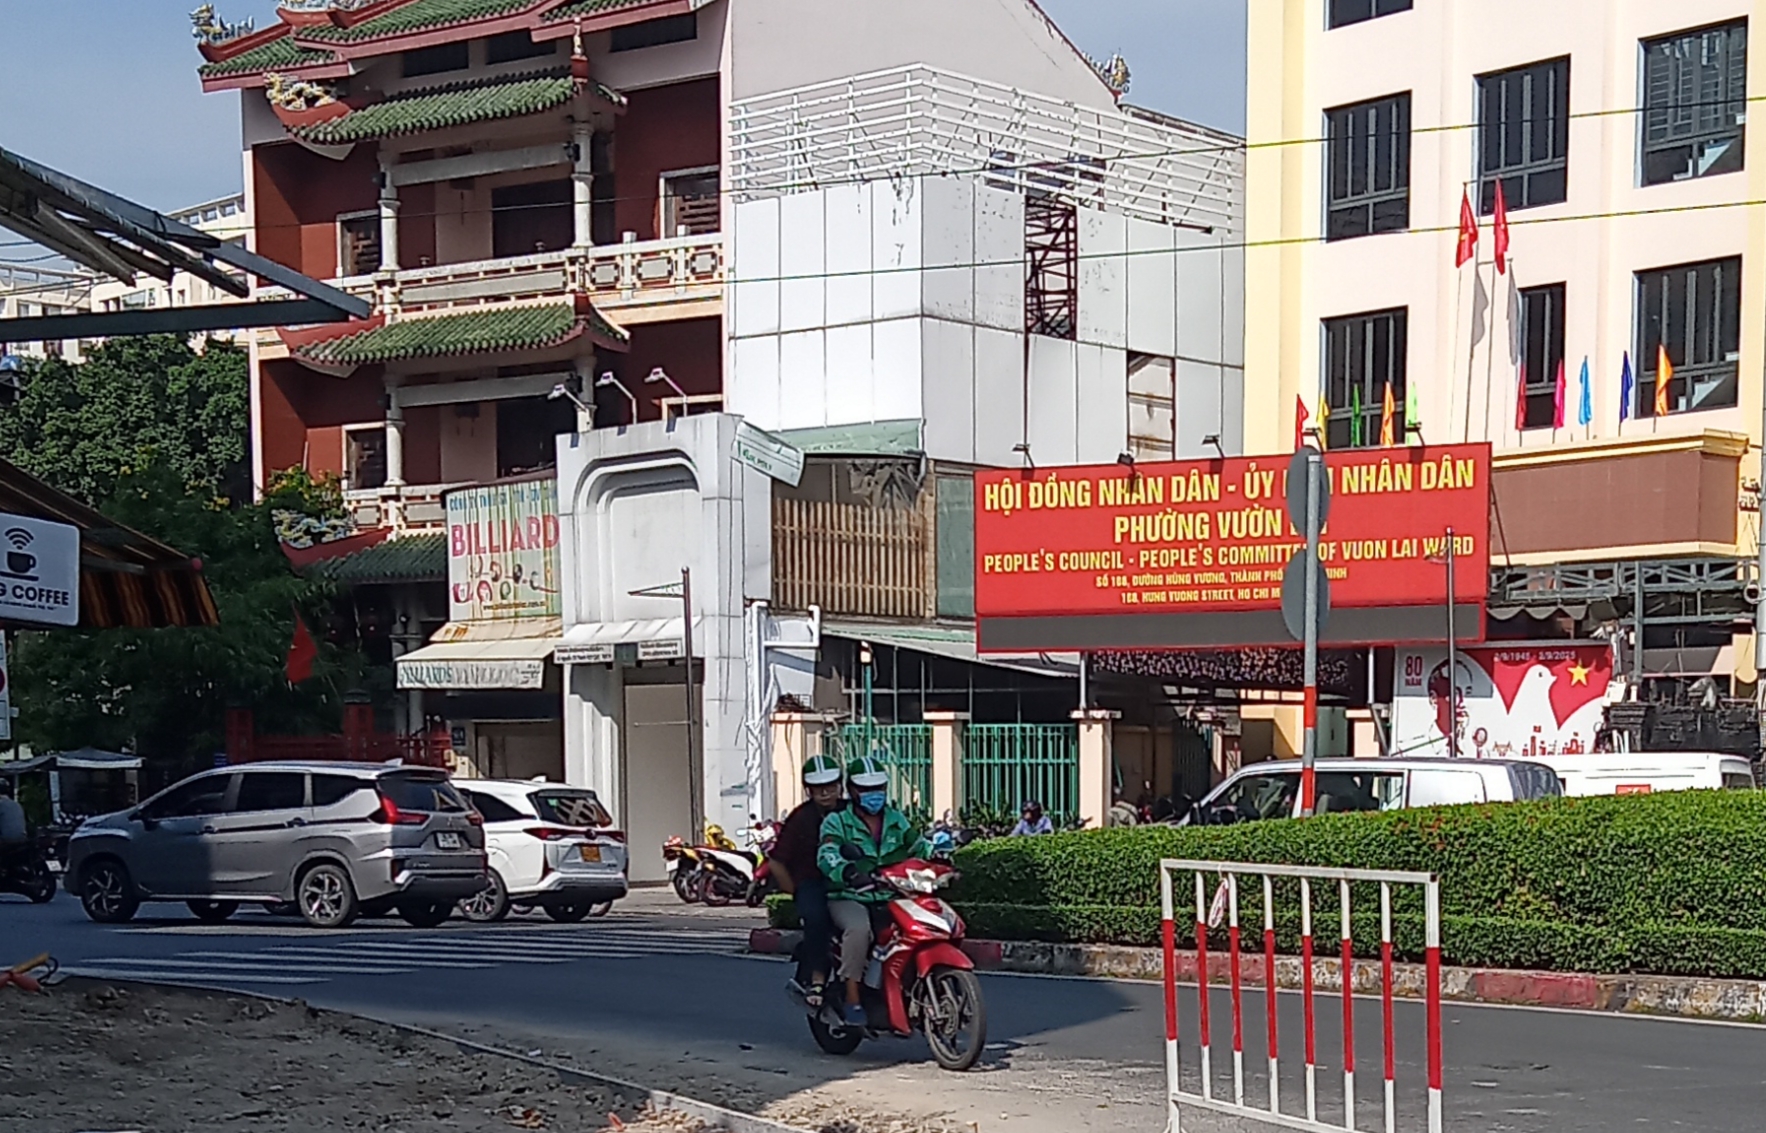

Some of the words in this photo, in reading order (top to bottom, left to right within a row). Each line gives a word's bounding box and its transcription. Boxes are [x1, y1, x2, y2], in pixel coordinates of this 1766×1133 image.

[984, 478, 1022, 516] HỘI
[1098, 471, 1164, 507] NHÂN
[1171, 468, 1220, 504] DÂN
[1243, 461, 1275, 500] ỦY
[1341, 458, 1413, 495] NHÂN
[1420, 453, 1475, 491] DÂN
[451, 514, 560, 557] BILLIARD
[1114, 507, 1210, 544] PHƯỜNG
[1216, 503, 1282, 540] VƯỜN
[984, 547, 1055, 573] PEOPLE'S
[1058, 550, 1124, 572] COUNCIL
[1139, 542, 1213, 569] PEOPLE'S
[1217, 543, 1307, 566] COMMITT
[1317, 541, 1338, 562] OF
[1341, 539, 1387, 561] VUON
[1391, 538, 1418, 558] LAI
[12, 584, 69, 606] COFFEE
[1404, 655, 1423, 677] 80
